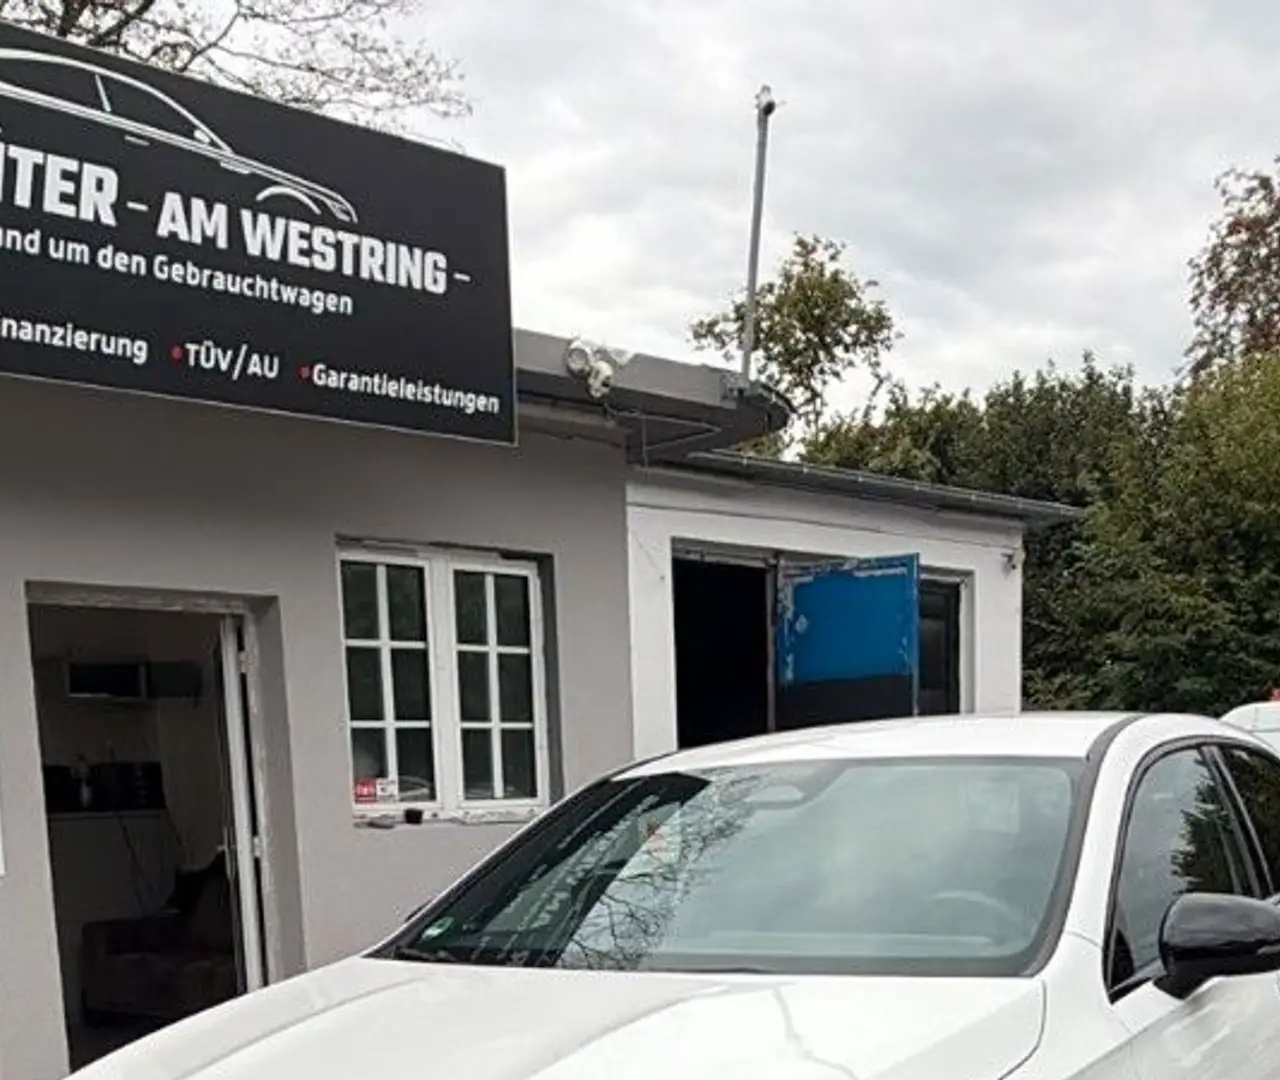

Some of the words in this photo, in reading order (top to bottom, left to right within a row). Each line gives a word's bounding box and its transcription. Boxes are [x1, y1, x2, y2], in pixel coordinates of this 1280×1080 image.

[156, 191, 228, 250] AM
[240, 208, 447, 294] WESTRING
[48, 237, 90, 265] um
[96, 244, 147, 276] den
[153, 254, 353, 315] Gebrauchtwagen
[185, 340, 279, 380] TÜV/AU
[312, 363, 499, 414] Garantieleistungen
